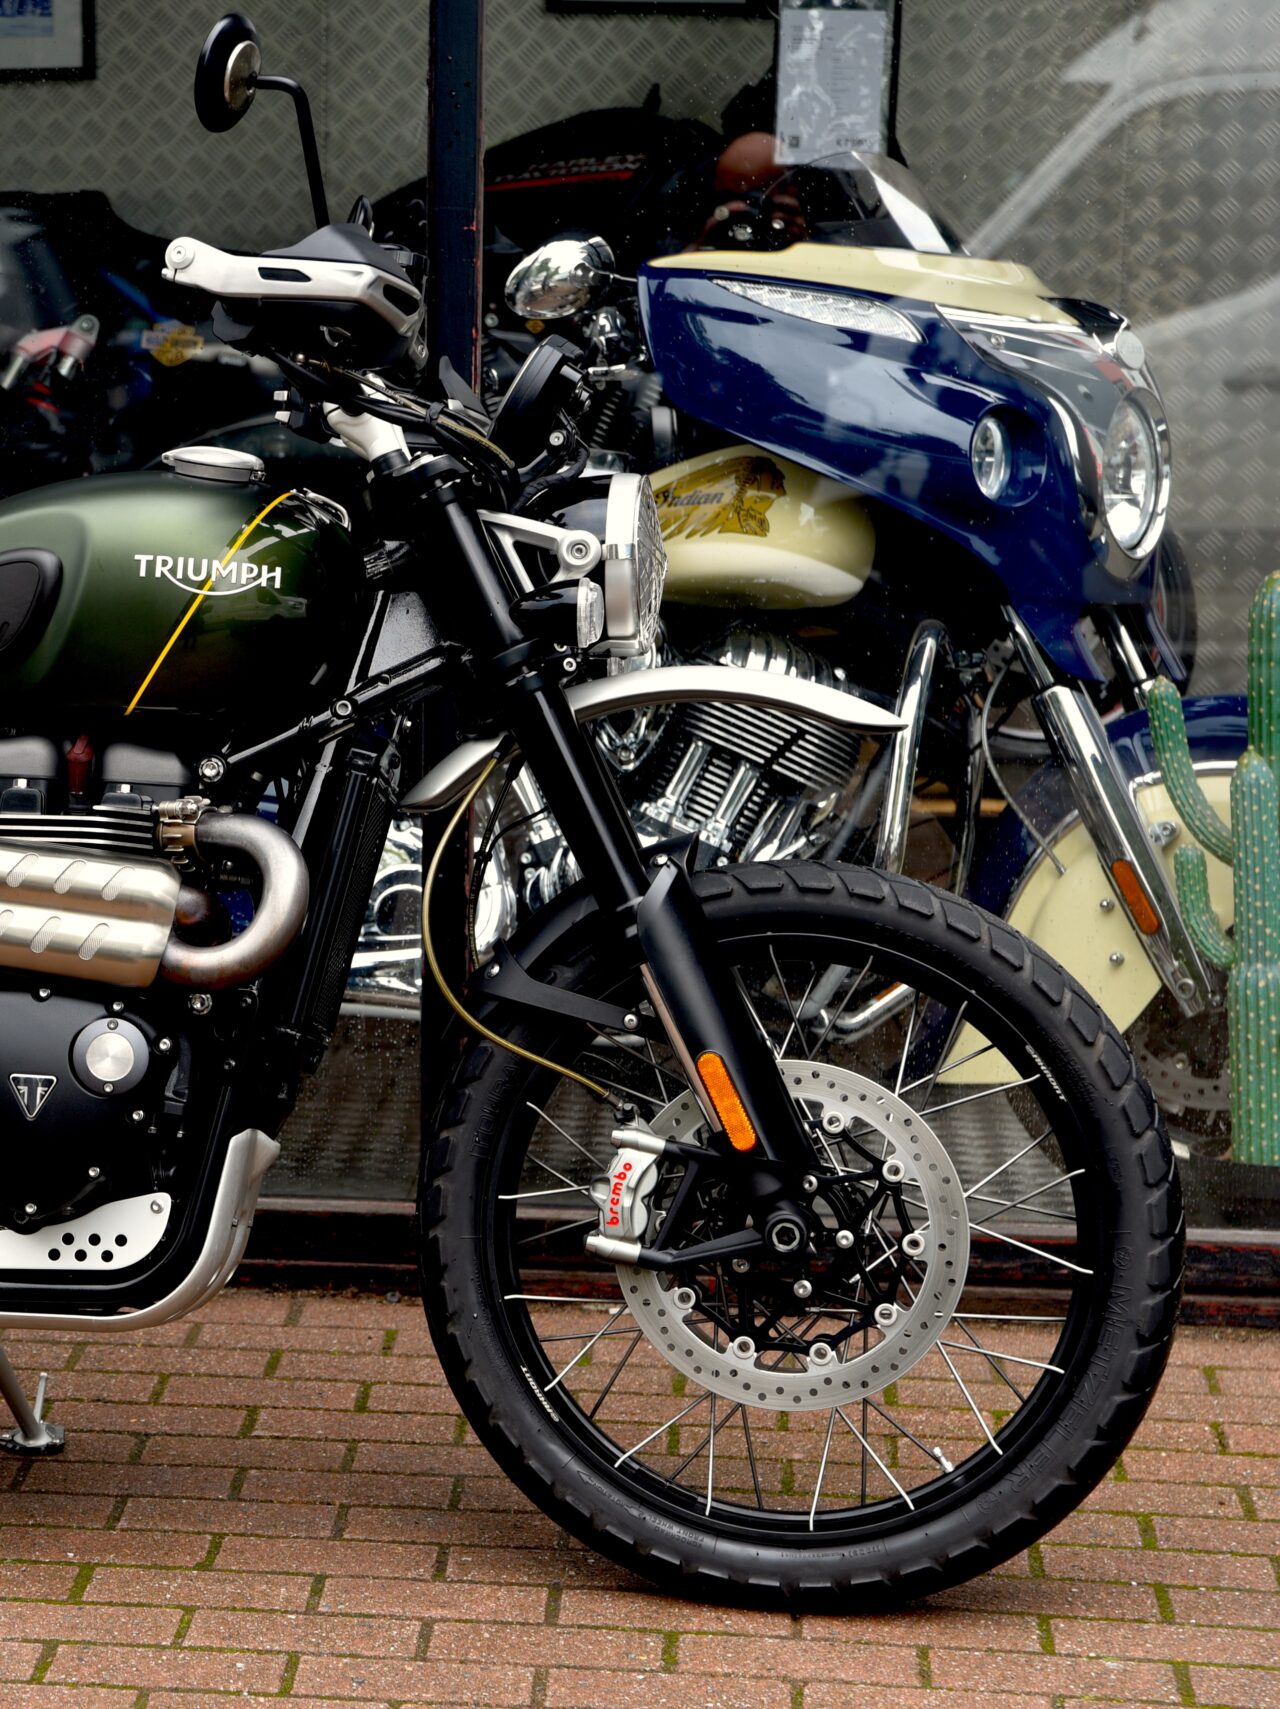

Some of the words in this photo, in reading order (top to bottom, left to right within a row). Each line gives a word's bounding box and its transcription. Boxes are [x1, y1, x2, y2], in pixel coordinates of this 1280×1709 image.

[134, 554, 282, 596] TRIUMPH
[606, 1162, 632, 1226] brembo
[1007, 1282, 1134, 1494] METZELER
